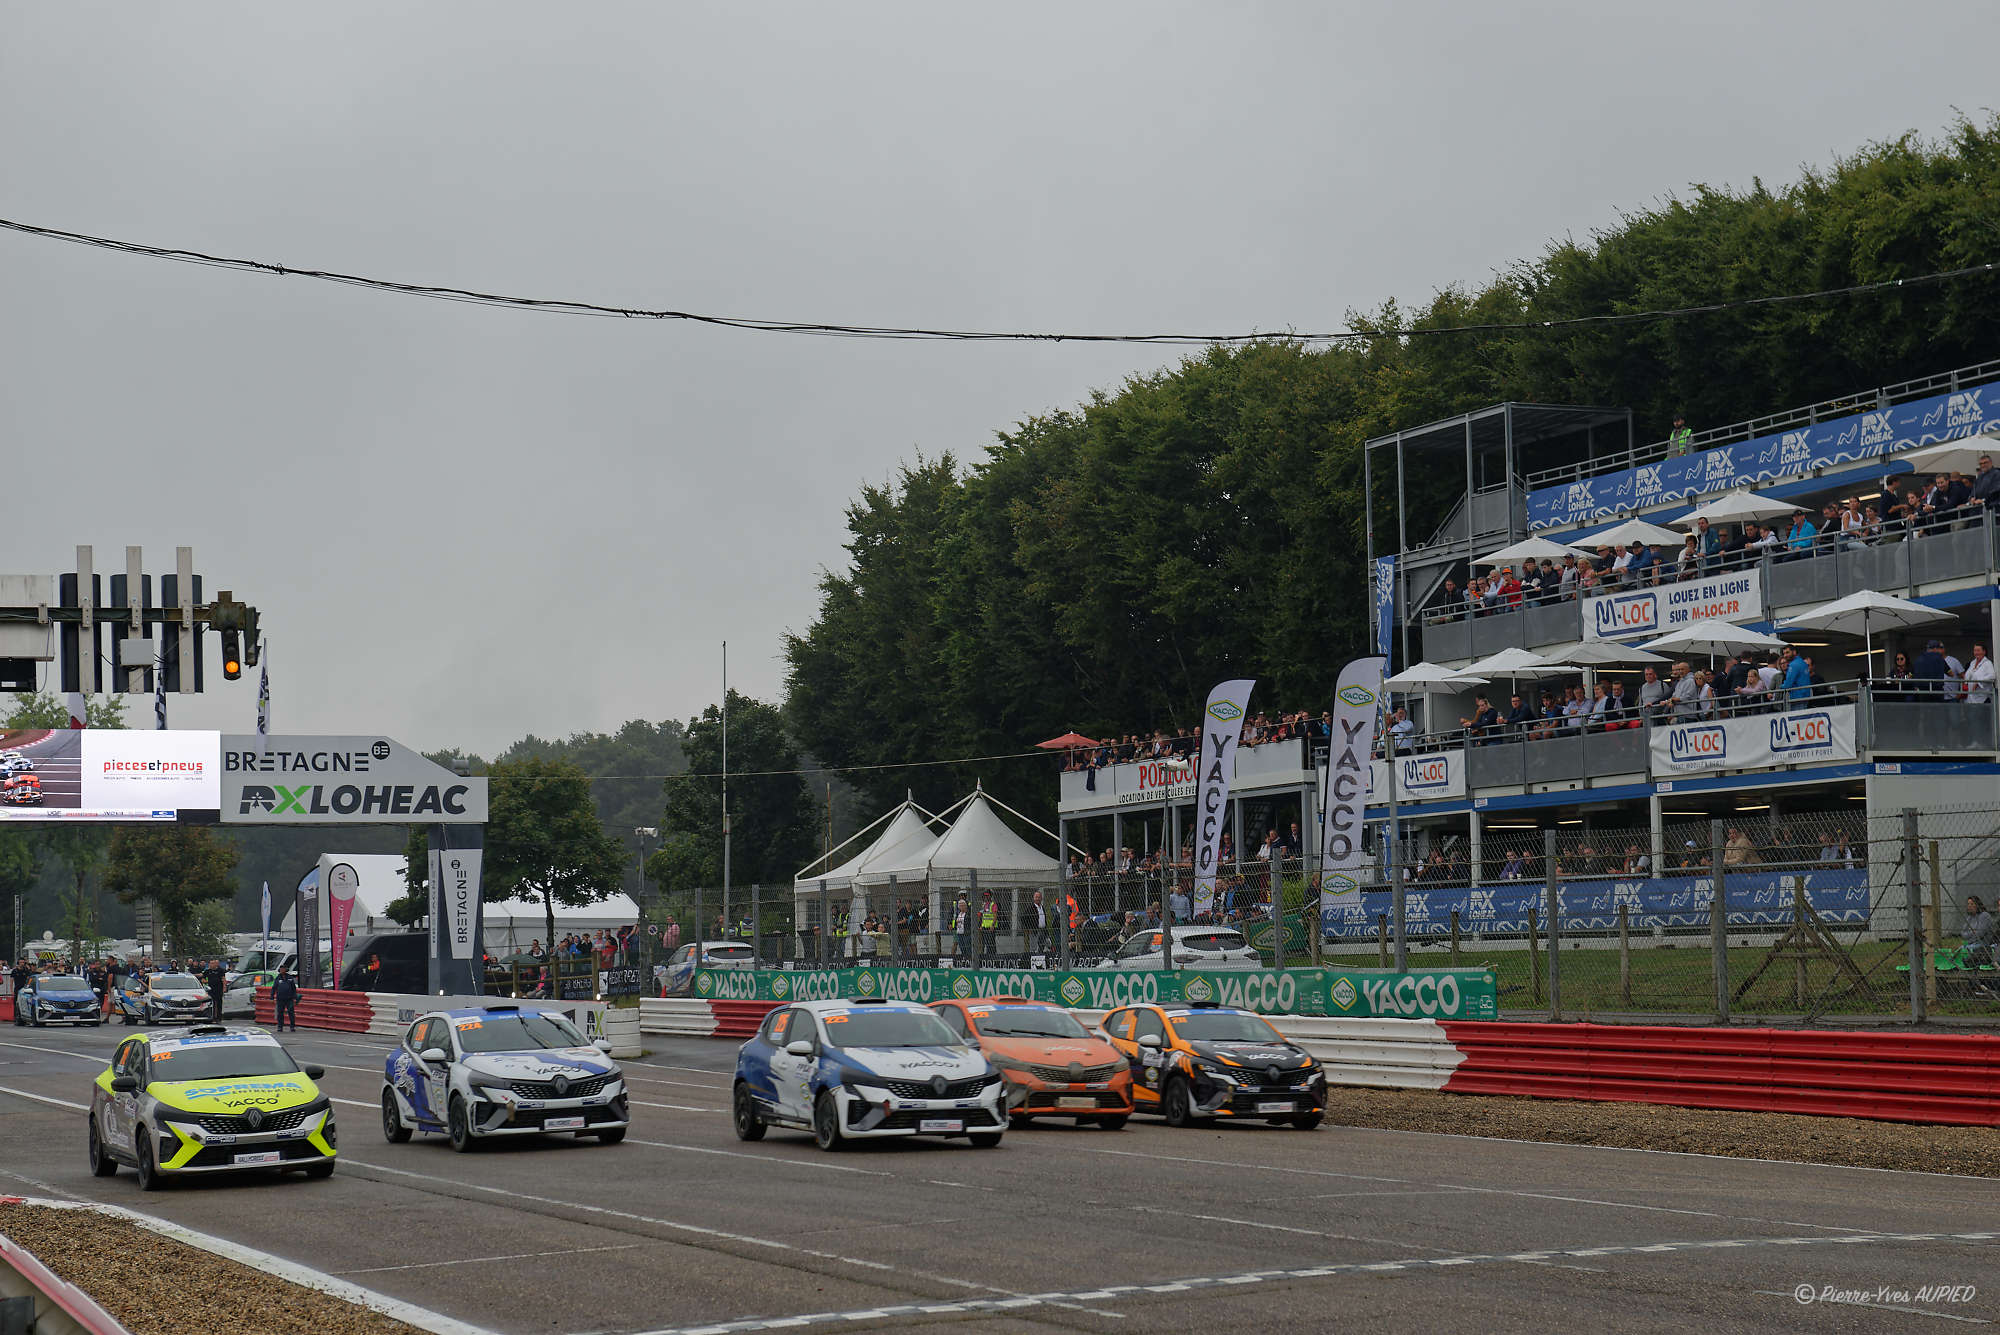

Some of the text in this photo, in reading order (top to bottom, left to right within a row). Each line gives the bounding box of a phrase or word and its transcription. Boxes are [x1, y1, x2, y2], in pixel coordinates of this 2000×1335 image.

[1947, 410, 1983, 427] LOHEAC
[1860, 430, 1894, 446] LOHEAC
[1781, 448, 1810, 464] LOHEAC
[1705, 466, 1735, 481] LOHEAC
[1635, 482, 1662, 497] LOHEAC
[1568, 498, 1595, 512] LOHEAC
[1669, 579, 1750, 605] LOUEZ EN LIGNE
[1596, 598, 1650, 627] M-LOC
[1669, 600, 1740, 623] SUR M-LOC.FR
[1671, 728, 1720, 754] M-LOC
[1771, 717, 1826, 743] M-LOC
[103, 759, 203, 773] piecesetpneus
[225, 751, 369, 772] BRETAGNE
[1404, 759, 1445, 781] M-LOC
[1119, 791, 1145, 804] LOCATION
[1146, 790, 1153, 800] DE
[1154, 786, 1184, 799] VEHCULES
[1200, 733, 1233, 871] YACCO
[1328, 718, 1367, 862] YACCO
[456, 870, 468, 943] BRETAGNE
[1613, 903, 1644, 914] LOEAC
[714, 972, 757, 999] YACCO
[791, 971, 839, 1000] YACCO
[877, 970, 932, 1000] YACCO
[974, 973, 1035, 999] YACCO
[1088, 973, 1158, 1008] YACCO
[1216, 973, 1296, 1011] YACCO
[1363, 975, 1460, 1015] YACCO
[223, 1098, 278, 1108] YACCO
